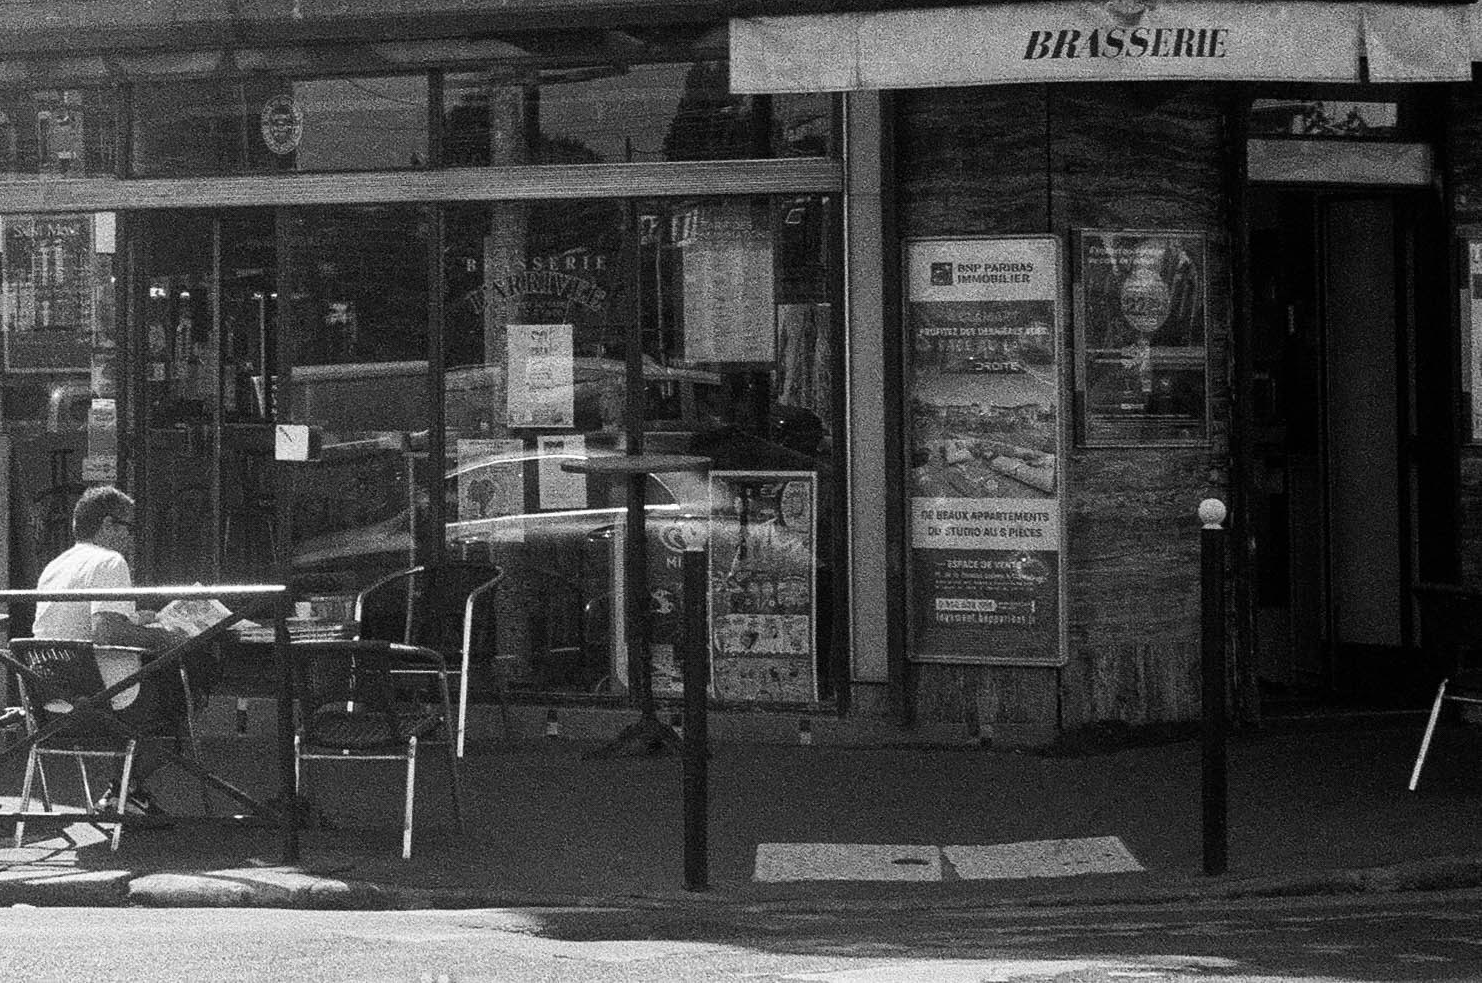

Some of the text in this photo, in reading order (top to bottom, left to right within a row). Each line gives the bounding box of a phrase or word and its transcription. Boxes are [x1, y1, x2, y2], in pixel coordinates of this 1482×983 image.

[1023, 27, 1231, 62] BRASSERIE
[956, 262, 1035, 273] BNP PARIBAS
[956, 273, 1031, 284] IMMOBILIER
[936, 510, 970, 522] BEAUX
[971, 511, 1050, 523] APPARTEMENTS
[944, 526, 981, 538] STUDIO
[982, 526, 998, 538] AU
